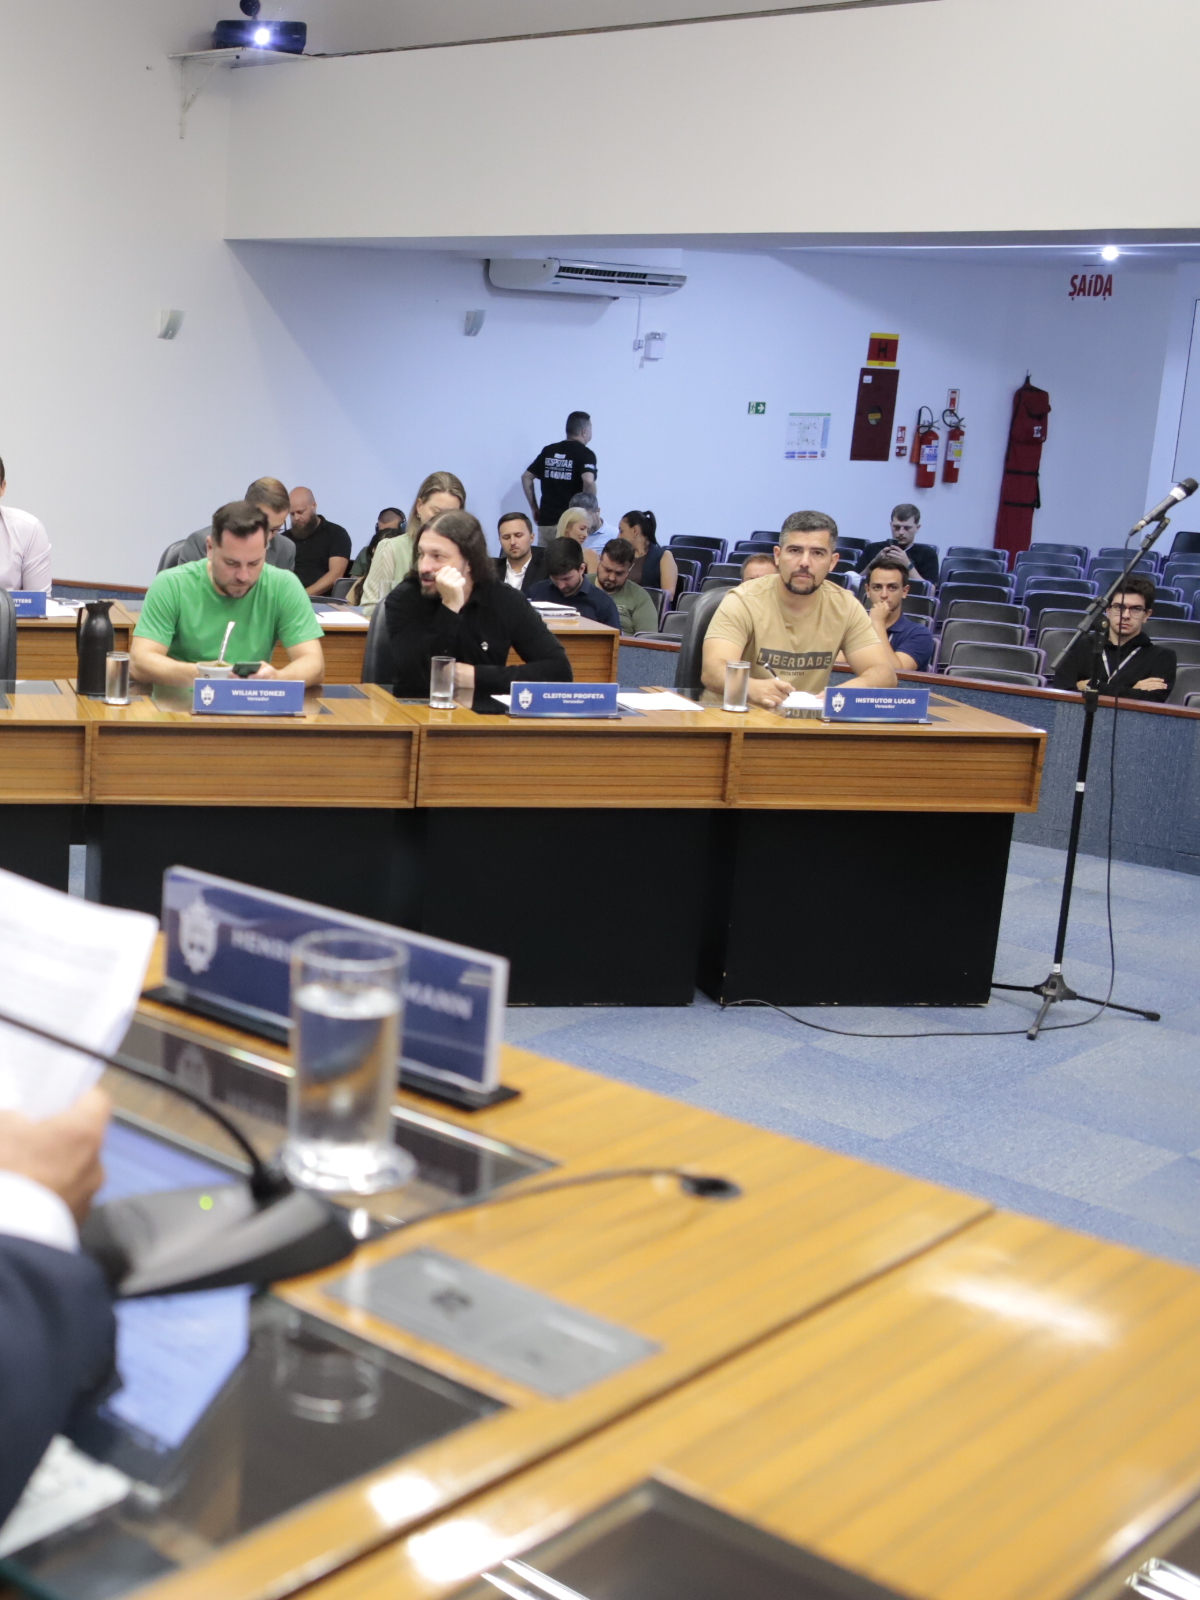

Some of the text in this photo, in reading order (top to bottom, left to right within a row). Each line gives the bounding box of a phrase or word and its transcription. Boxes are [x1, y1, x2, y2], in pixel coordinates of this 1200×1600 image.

[1068, 274, 1112, 296] SAÍDA
[878, 341, 888, 358] H
[758, 652, 832, 668] LIBERDADE
